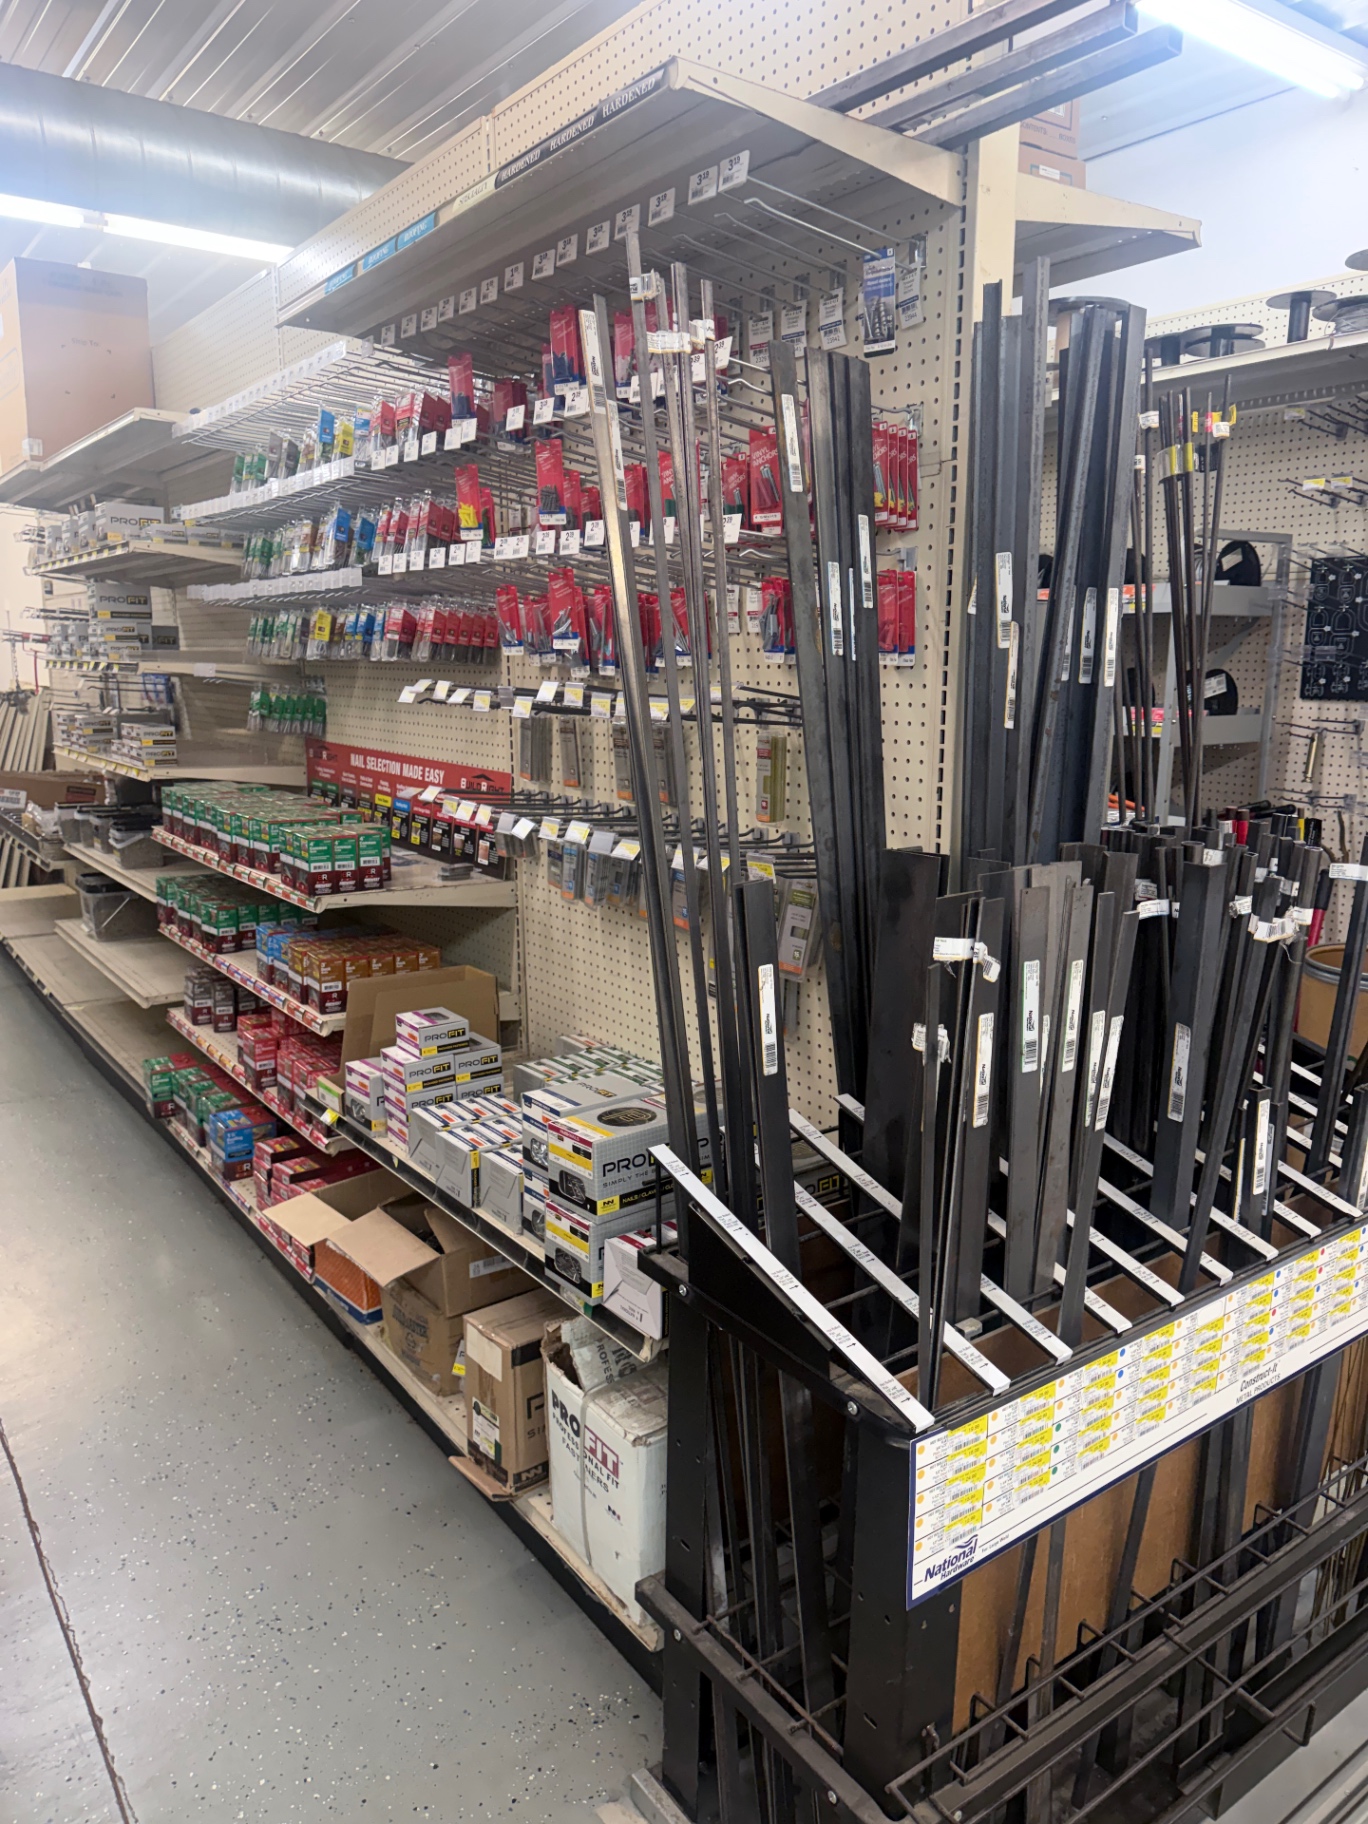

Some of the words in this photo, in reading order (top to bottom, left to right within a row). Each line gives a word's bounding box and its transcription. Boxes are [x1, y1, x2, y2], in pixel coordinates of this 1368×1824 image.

[602, 77, 656, 119] HARDENED
[550, 116, 595, 151] HARDENED
[500, 150, 541, 182] HARDENED
[752, 446, 769, 460] VINYL
[99, 595, 148, 605] PROFIT
[350, 753, 365, 769] NAIL
[366, 756, 401, 776] SELECTION
[402, 763, 423, 780] MADE
[424, 767, 445, 784] EASY
[424, 1028, 466, 1042] PROFIT
[409, 1062, 451, 1078] PROFIT
[458, 1054, 498, 1069] PROFIT
[411, 1093, 453, 1109] PROFIT
[461, 1084, 501, 1099] PROFIT
[602, 1174, 632, 1188] SIMPLY
[635, 1170, 649, 1179] THE
[641, 1186, 657, 1198] CLAV
[1236, 1390, 1252, 1405] METAL
[1254, 1373, 1281, 1394] PRODUCTS
[1240, 1362, 1278, 1392] Construct-It
[553, 1412, 605, 1477] PROFESSONAL
[606, 1472, 620, 1489] FIT
[561, 1436, 609, 1493] FASTNERS
[924, 1538, 978, 1582] National
[940, 1555, 975, 1580] Hardware
